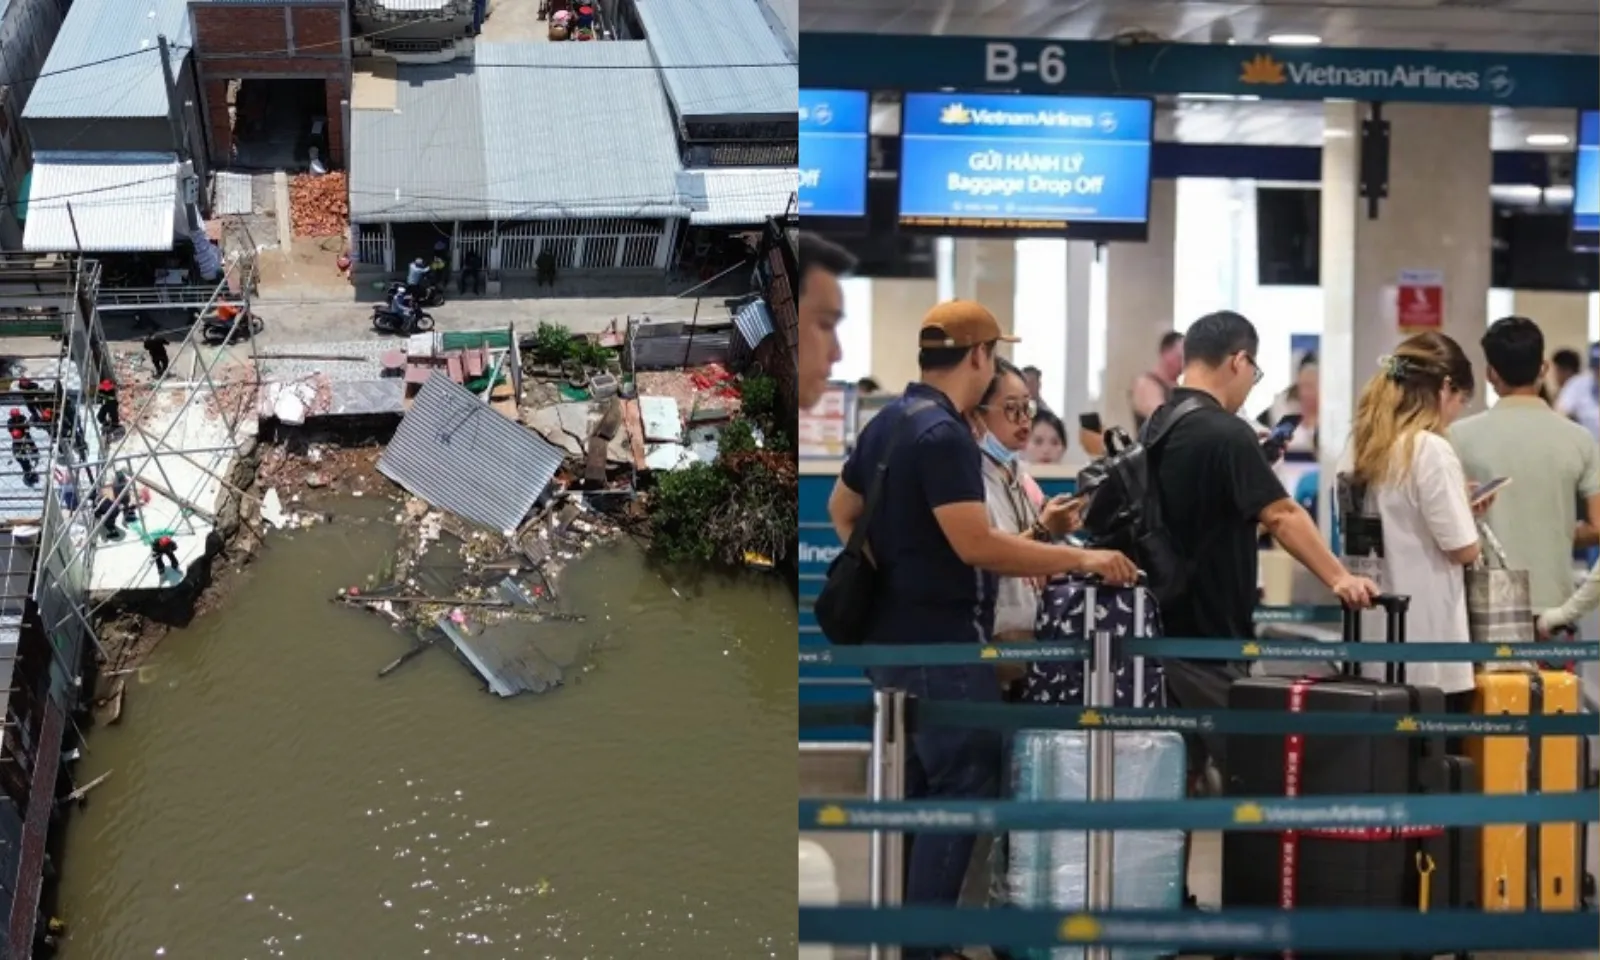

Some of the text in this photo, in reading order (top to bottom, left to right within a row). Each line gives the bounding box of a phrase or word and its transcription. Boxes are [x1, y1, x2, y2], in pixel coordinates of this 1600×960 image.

[985, 43, 1067, 85] B-6
[1006, 150, 1059, 172] HÀNH
[1063, 151, 1085, 172] LÝ
[947, 173, 1105, 197] Baggage Drop Off
